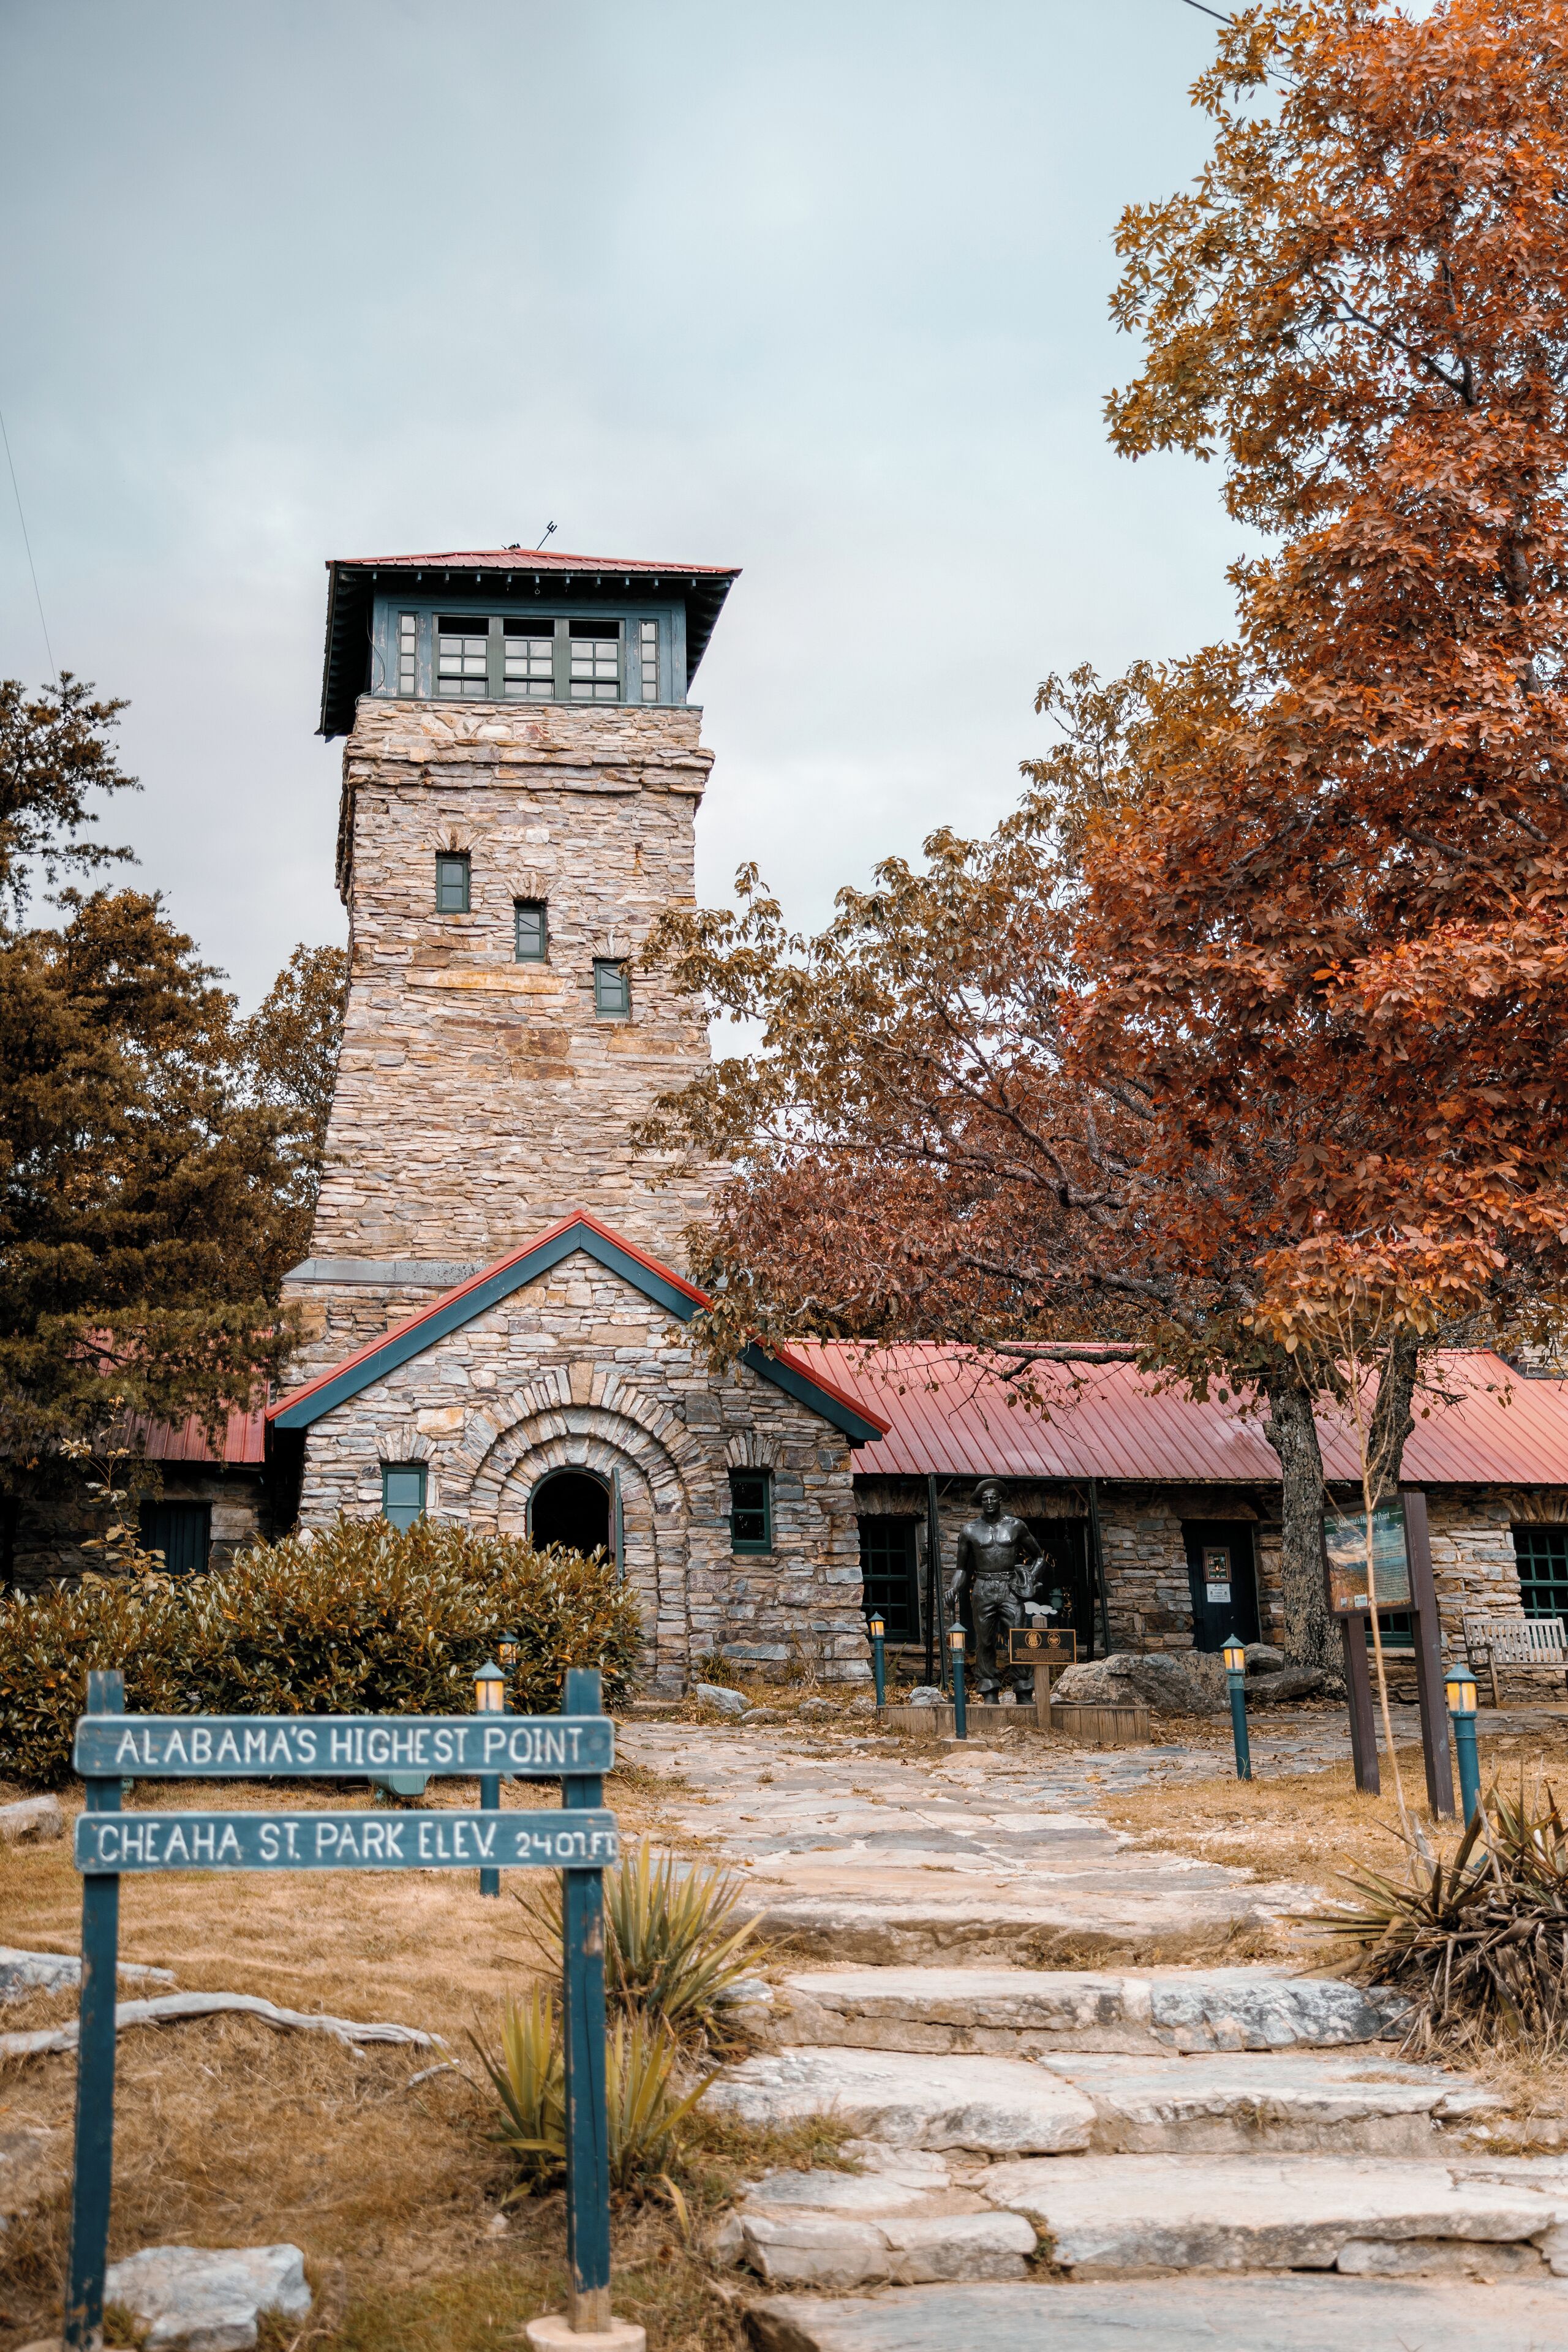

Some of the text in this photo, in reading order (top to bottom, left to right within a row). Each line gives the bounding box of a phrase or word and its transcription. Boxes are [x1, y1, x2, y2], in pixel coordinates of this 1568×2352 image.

[1378, 1511, 1390, 1521] Point
[115, 1725, 582, 1764] ALABAMA'S HIGHEST POINT
[98, 1822, 243, 1862] CHEAHA
[258, 1822, 301, 1860] ST.
[316, 1822, 404, 1858] PARK
[418, 1821, 497, 1858] ELEV.
